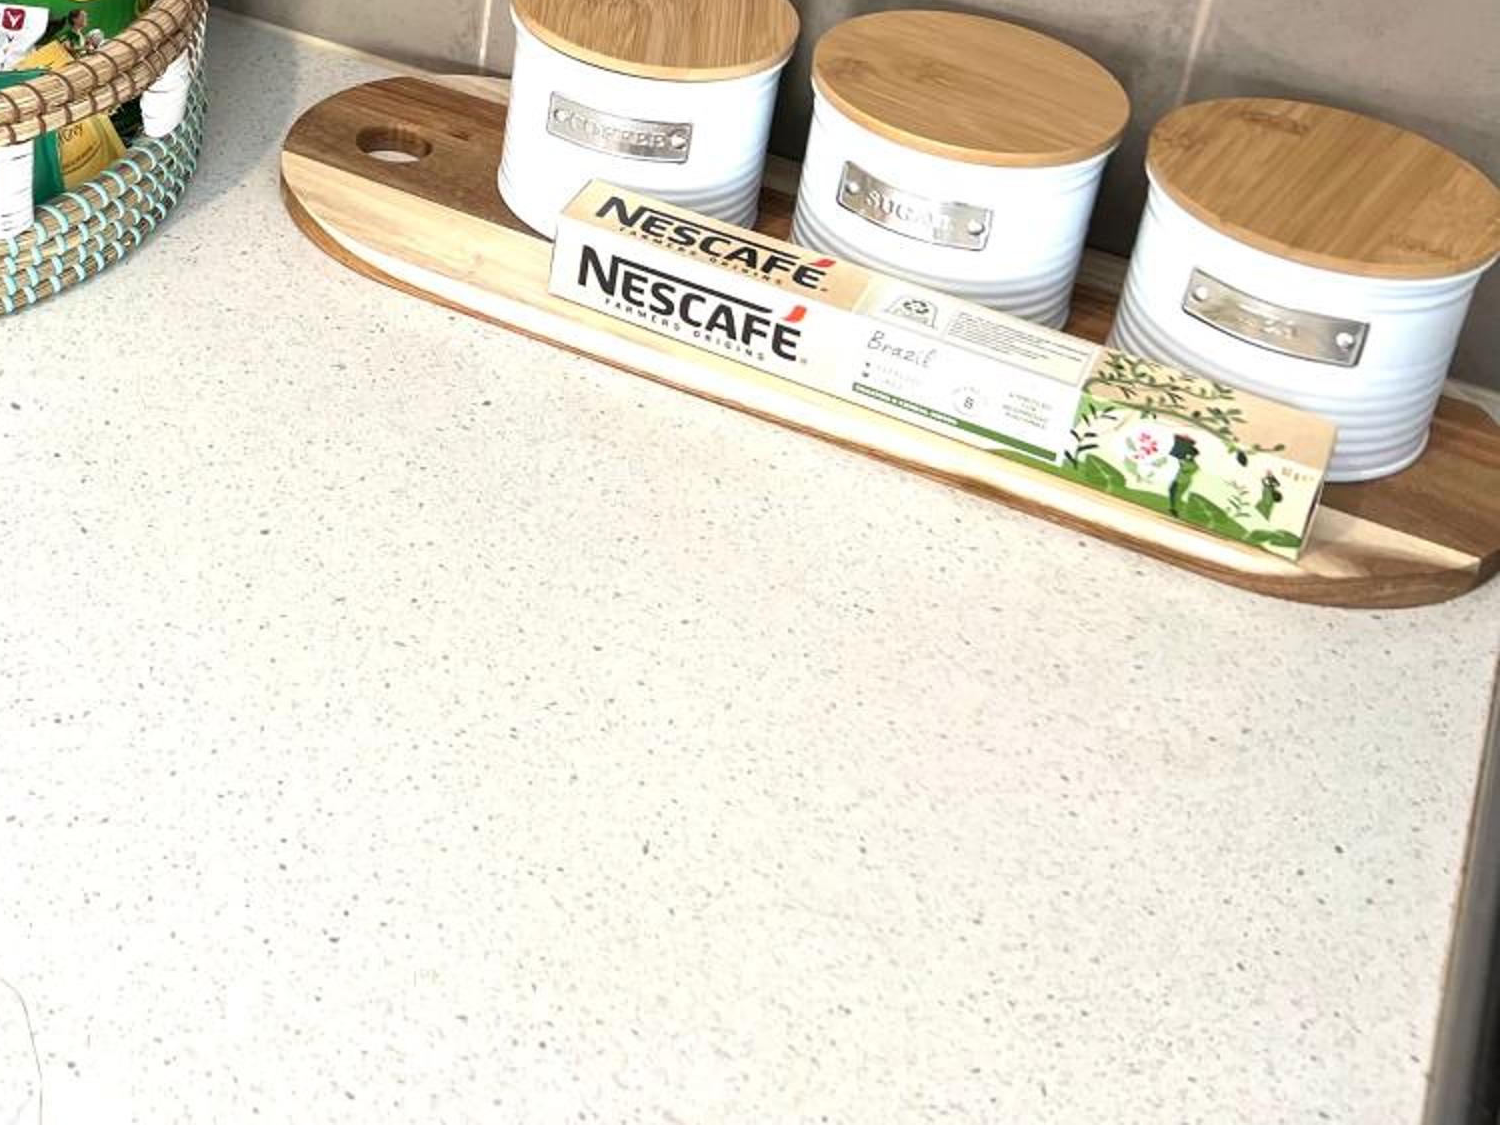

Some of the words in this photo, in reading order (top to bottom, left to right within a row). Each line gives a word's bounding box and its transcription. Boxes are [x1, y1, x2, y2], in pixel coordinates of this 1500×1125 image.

[595, 195, 837, 291] NESCAFÉ
[577, 244, 808, 362] NESCAFÉ
[604, 297, 681, 332] FARMERS
[693, 329, 766, 362] ORIGINS
[866, 329, 938, 368] Brazil
